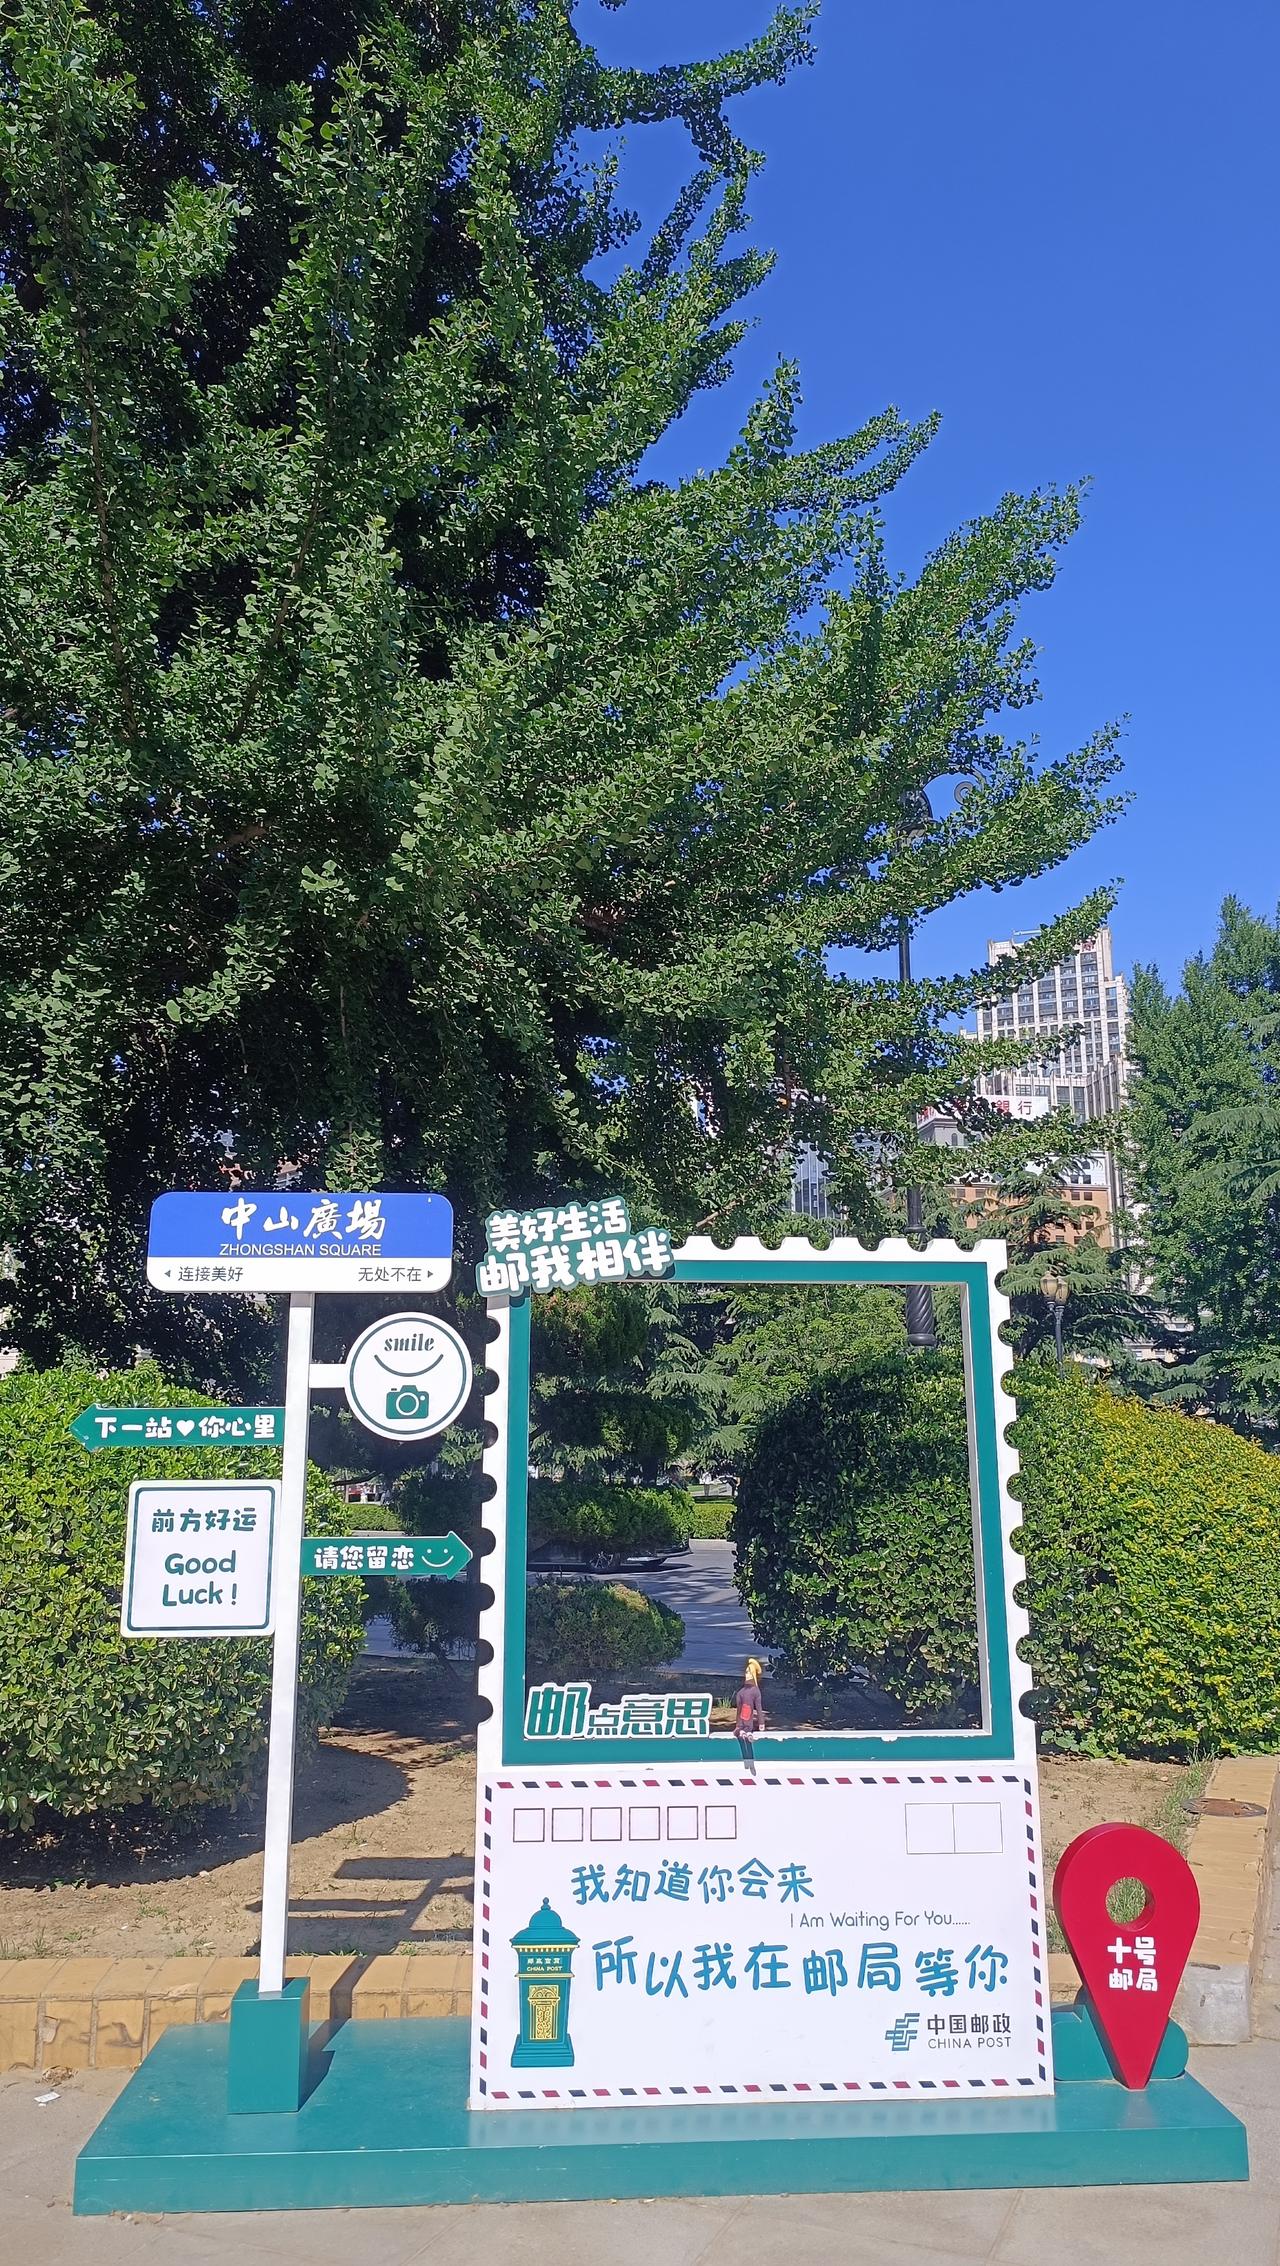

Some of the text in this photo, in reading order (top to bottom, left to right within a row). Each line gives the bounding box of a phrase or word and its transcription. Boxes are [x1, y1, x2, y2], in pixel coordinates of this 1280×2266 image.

[221, 1197, 386, 1241] 中山廣場
[489, 1199, 627, 1252] 美好生活
[219, 1243, 382, 1256] ZHONGSHAN SQUARE
[480, 1231, 671, 1292] 邮我相伴
[178, 1267, 243, 1282] 连接美好
[358, 1267, 422, 1282] 无处不在
[384, 1333, 435, 1352] smile
[151, 1508, 257, 1532] 前方好运
[164, 1550, 237, 1576] Good
[314, 1546, 415, 1571] 请您留恋
[527, 1686, 710, 1736] 邮点意思
[570, 1857, 815, 1905] 我知道你会来
[790, 1913, 794, 1928] I
[799, 1913, 824, 1928] Am
[829, 1911, 890, 1931] Waiting
[895, 1911, 920, 1926] For
[1107, 1936, 1157, 1965] 十号
[591, 1935, 1009, 1998] 所以我在邮局等你
[1108, 1968, 1158, 1992] 邮局
[927, 2013, 1011, 2035] 中国邮政
[927, 2037, 1012, 2049] CHINA POST
